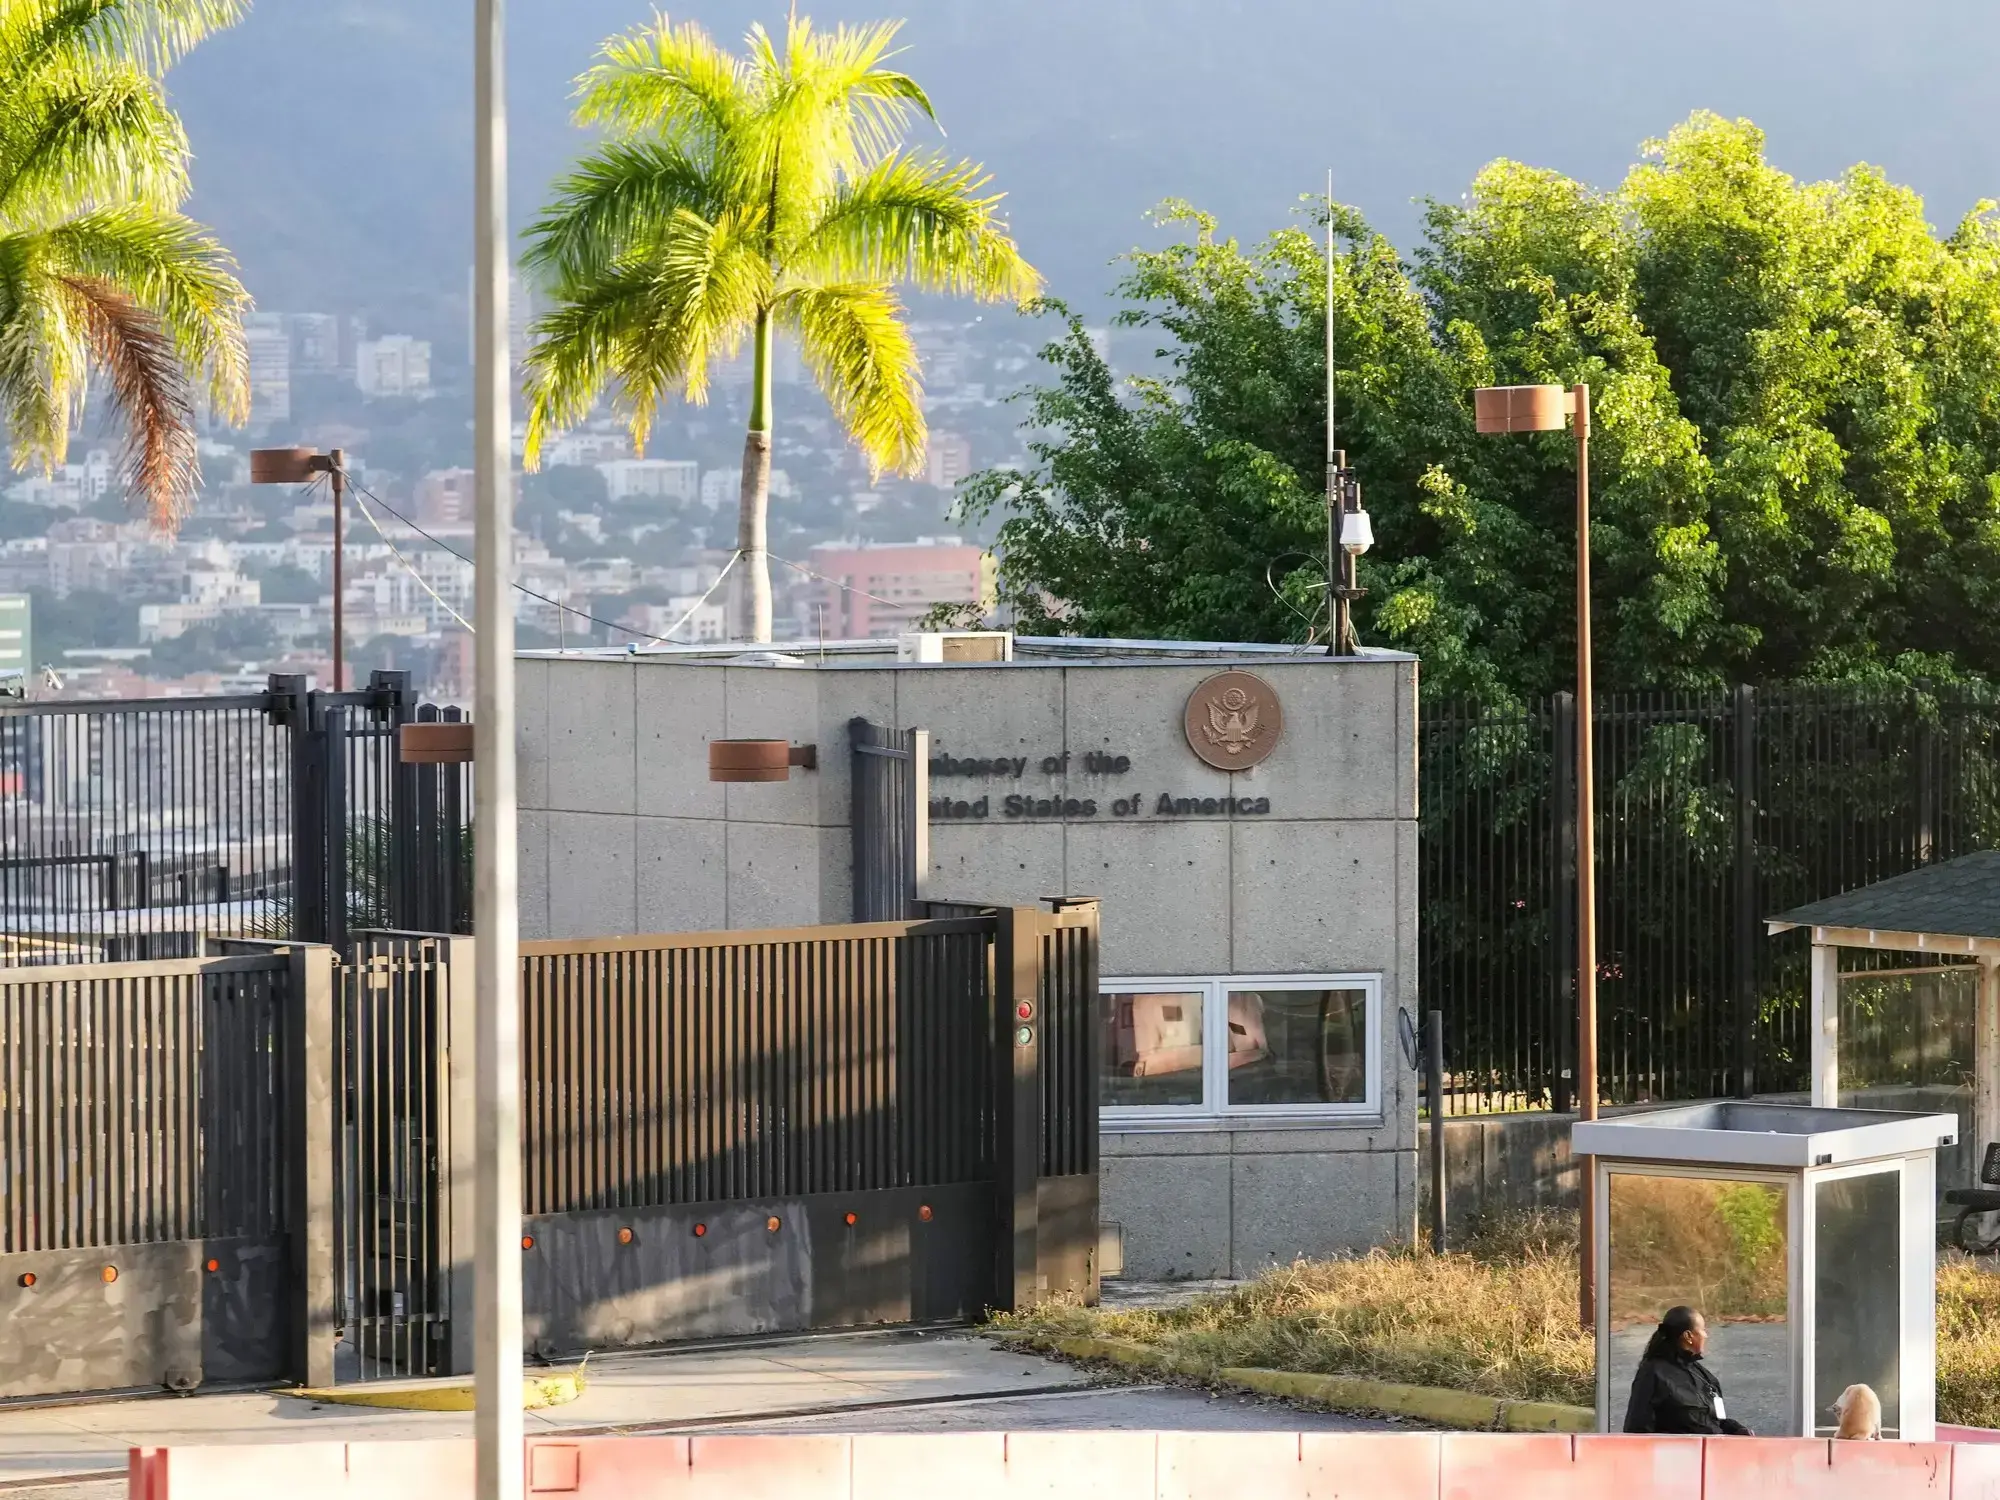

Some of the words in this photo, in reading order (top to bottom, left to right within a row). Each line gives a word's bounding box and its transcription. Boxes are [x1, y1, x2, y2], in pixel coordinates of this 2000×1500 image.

[928, 751, 1027, 778] mbassy
[1041, 750, 1071, 775] of
[1084, 749, 1132, 774] the
[1005, 794, 1098, 818] States
[1111, 793, 1141, 816] of
[1156, 792, 1270, 816] America
